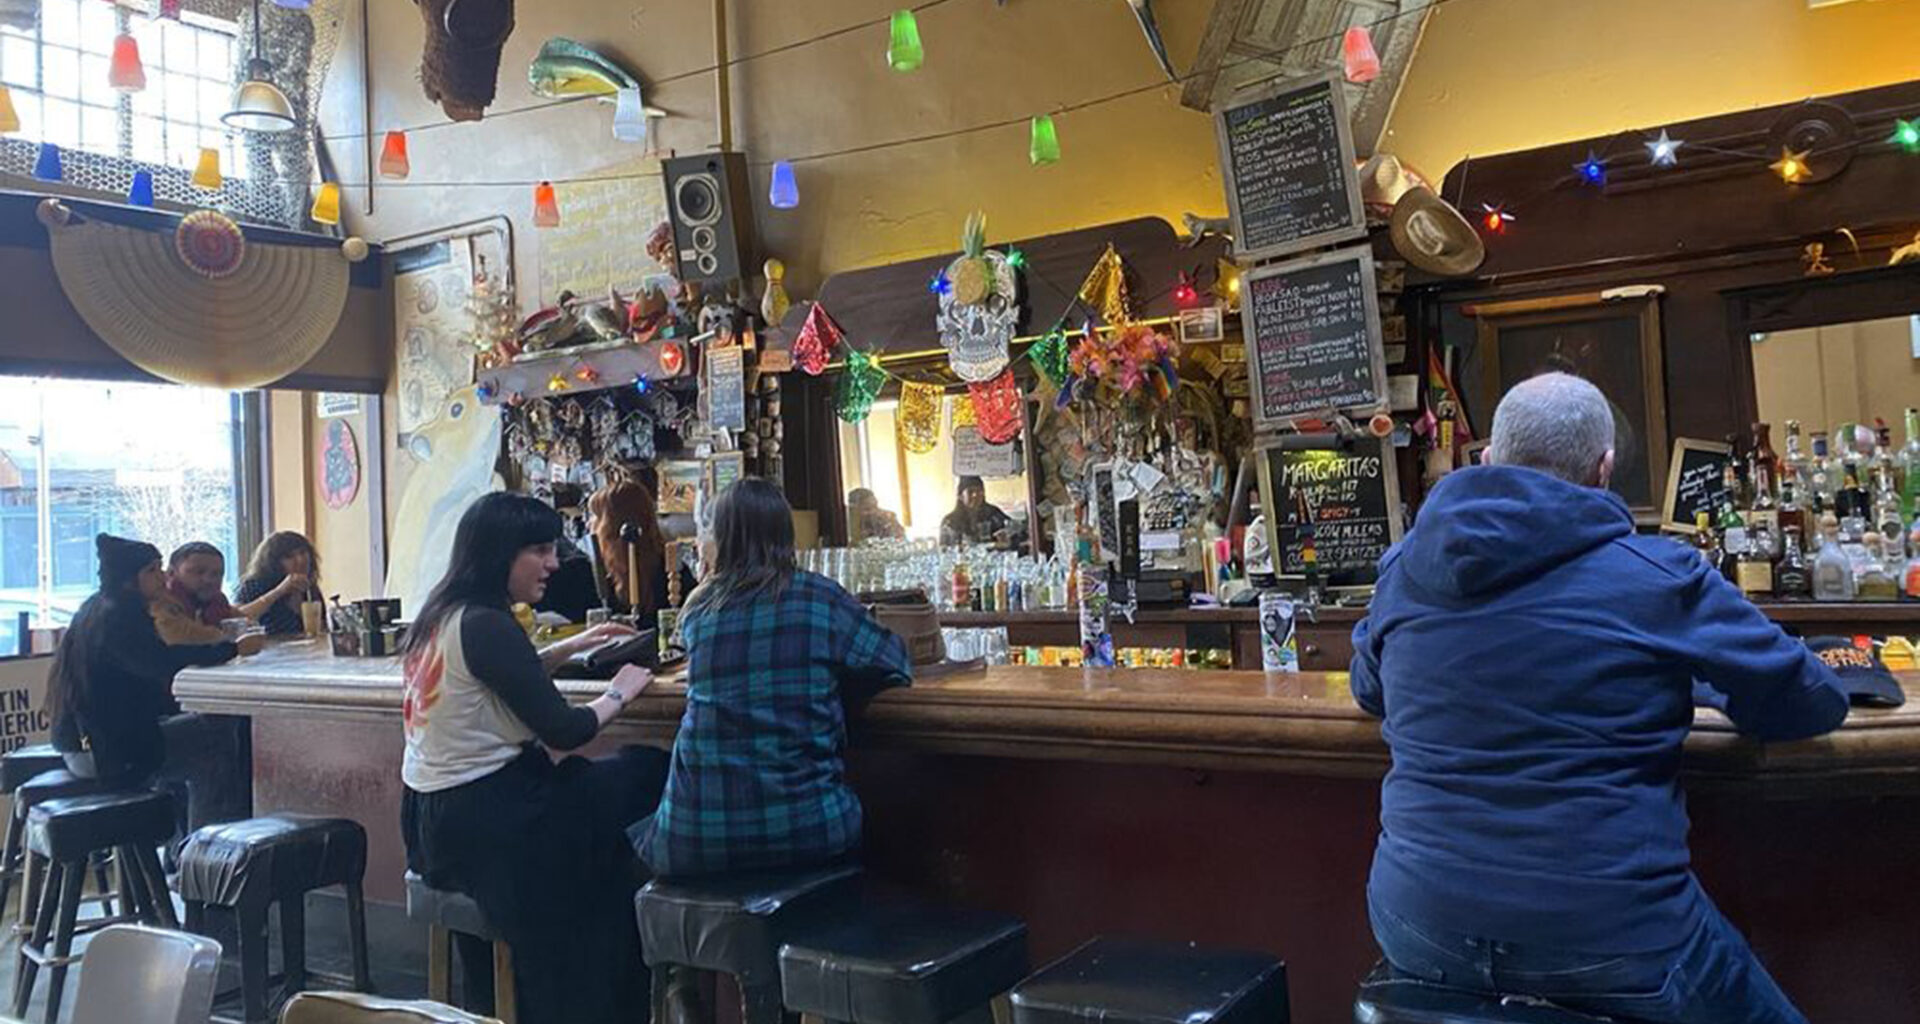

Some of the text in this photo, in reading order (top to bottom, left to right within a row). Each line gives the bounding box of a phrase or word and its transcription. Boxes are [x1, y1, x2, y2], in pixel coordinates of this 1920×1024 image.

[1281, 456, 1380, 487] MARGARITAS
[0, 689, 29, 712] TIN
[0, 709, 49, 736] ERIC
